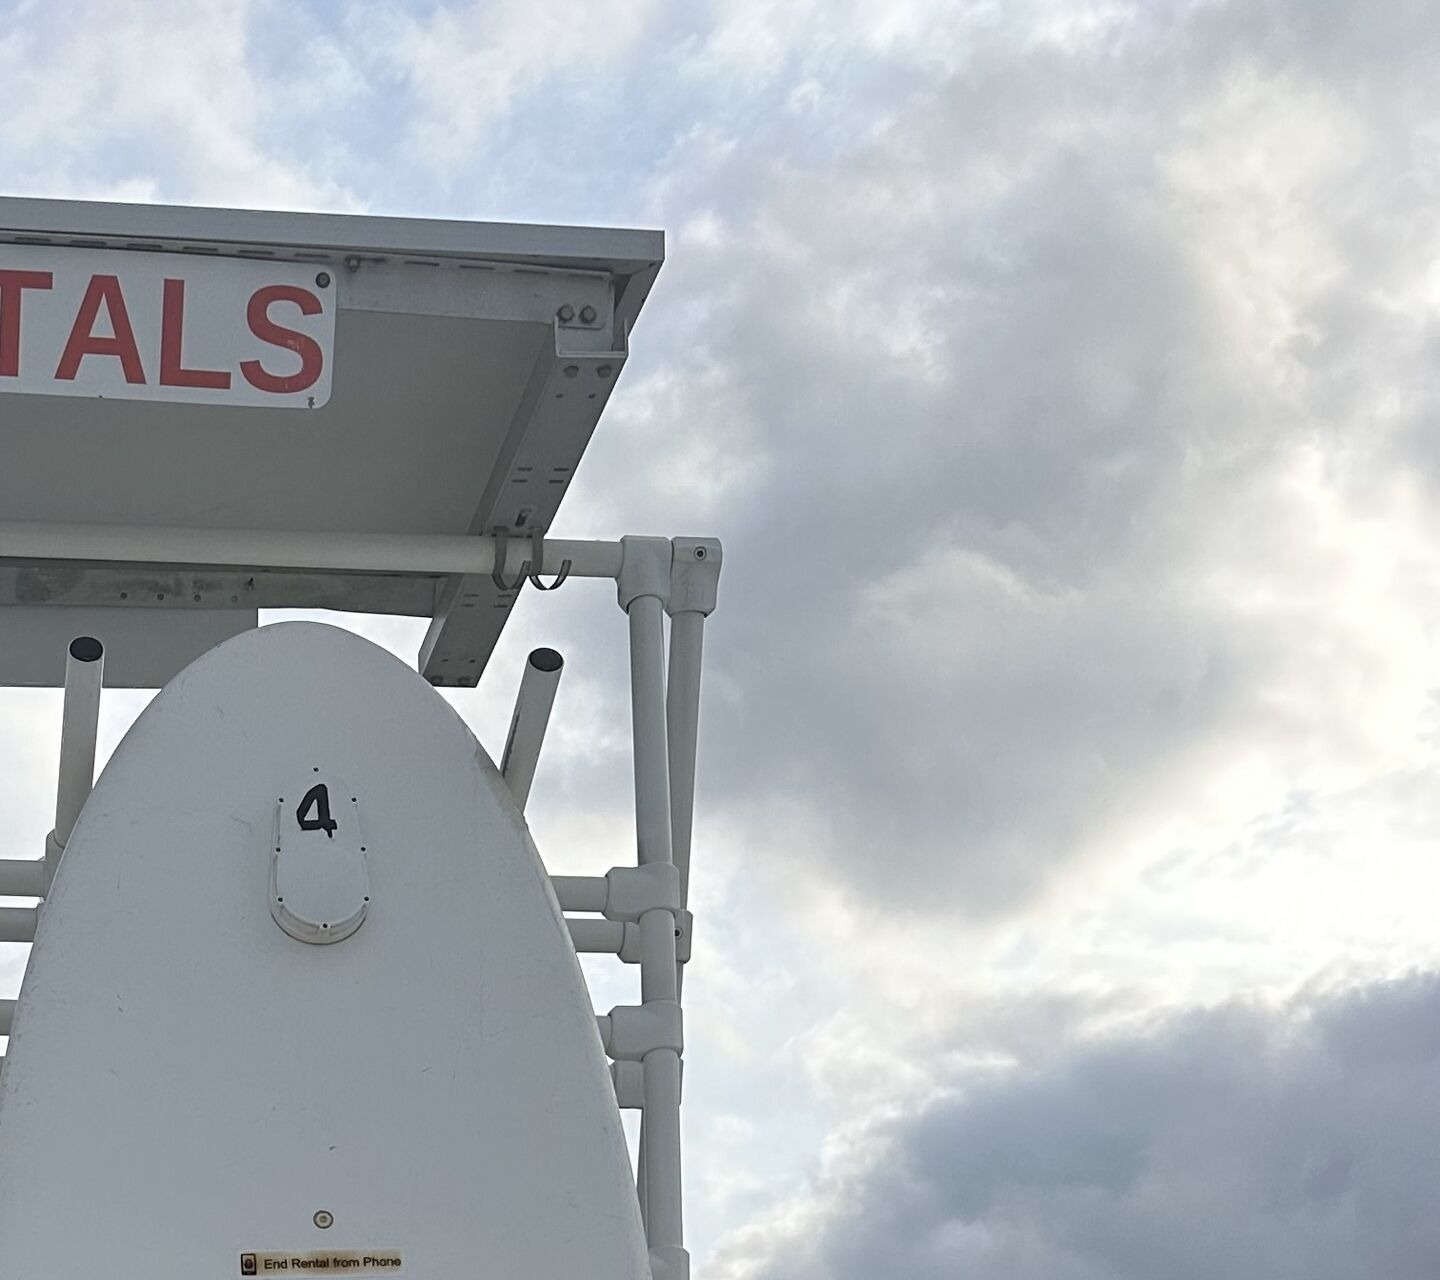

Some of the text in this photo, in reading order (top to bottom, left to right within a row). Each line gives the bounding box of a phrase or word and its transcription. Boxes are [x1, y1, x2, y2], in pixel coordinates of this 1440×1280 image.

[296, 783, 338, 839] 4
[264, 1256, 402, 1270] End Rental from Phone
